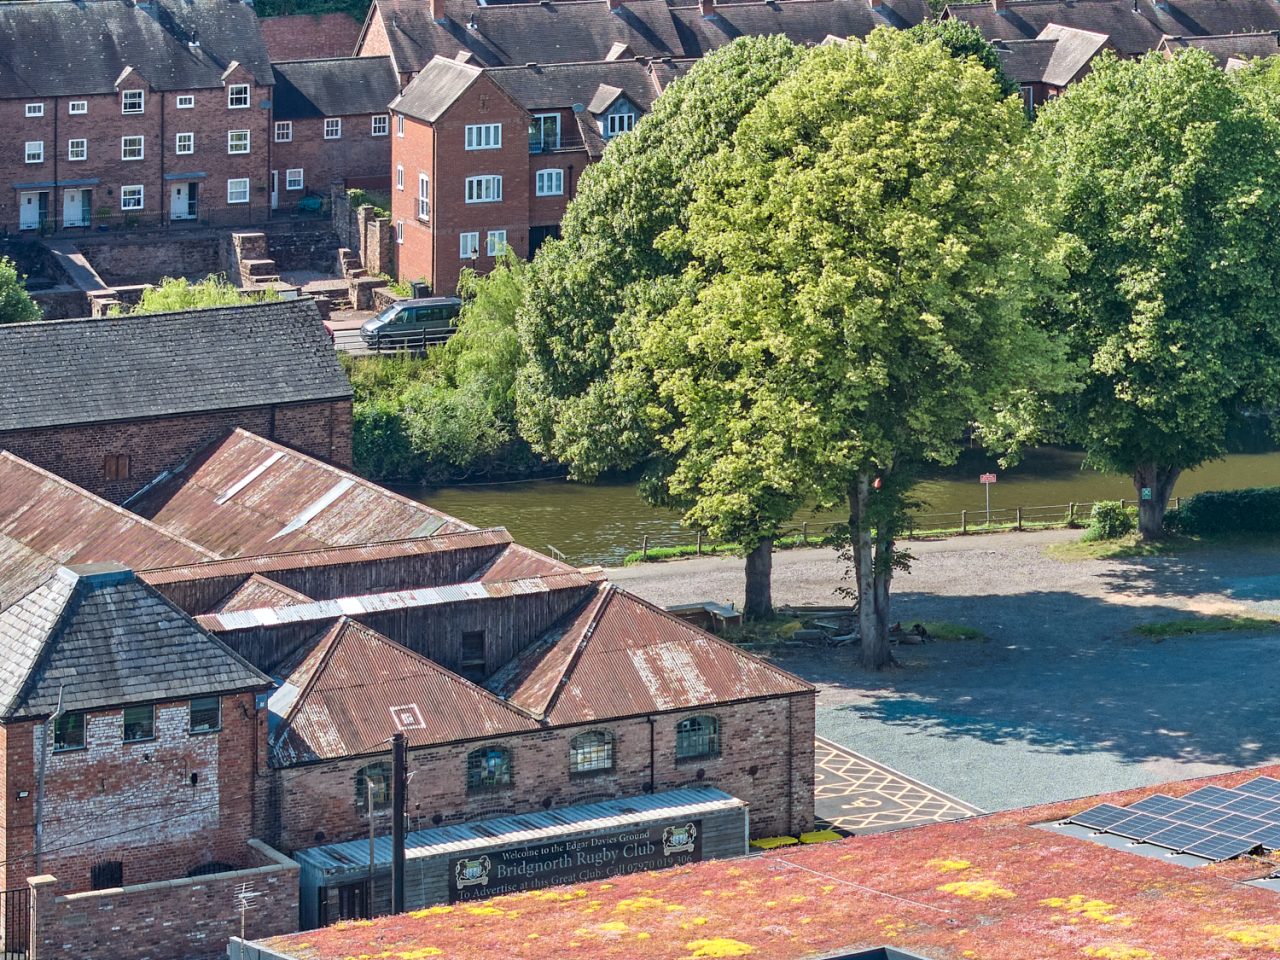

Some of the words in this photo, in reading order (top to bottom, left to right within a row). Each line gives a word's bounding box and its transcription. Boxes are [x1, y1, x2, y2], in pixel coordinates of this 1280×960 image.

[497, 853, 572, 878] Bridgnorth
[576, 847, 619, 866] Rugby
[623, 841, 655, 858] Club
[502, 847, 539, 860] Welcome
[541, 847, 549, 855] to
[551, 845, 563, 853] the
[566, 841, 588, 851] Edgar
[591, 836, 617, 847] Davies
[619, 831, 650, 842] Ground
[458, 890, 470, 899] To
[472, 883, 517, 897] Advertise
[520, 881, 528, 889] at
[531, 877, 549, 888] this
[551, 873, 576, 884] Great
[606, 863, 625, 875] Call
